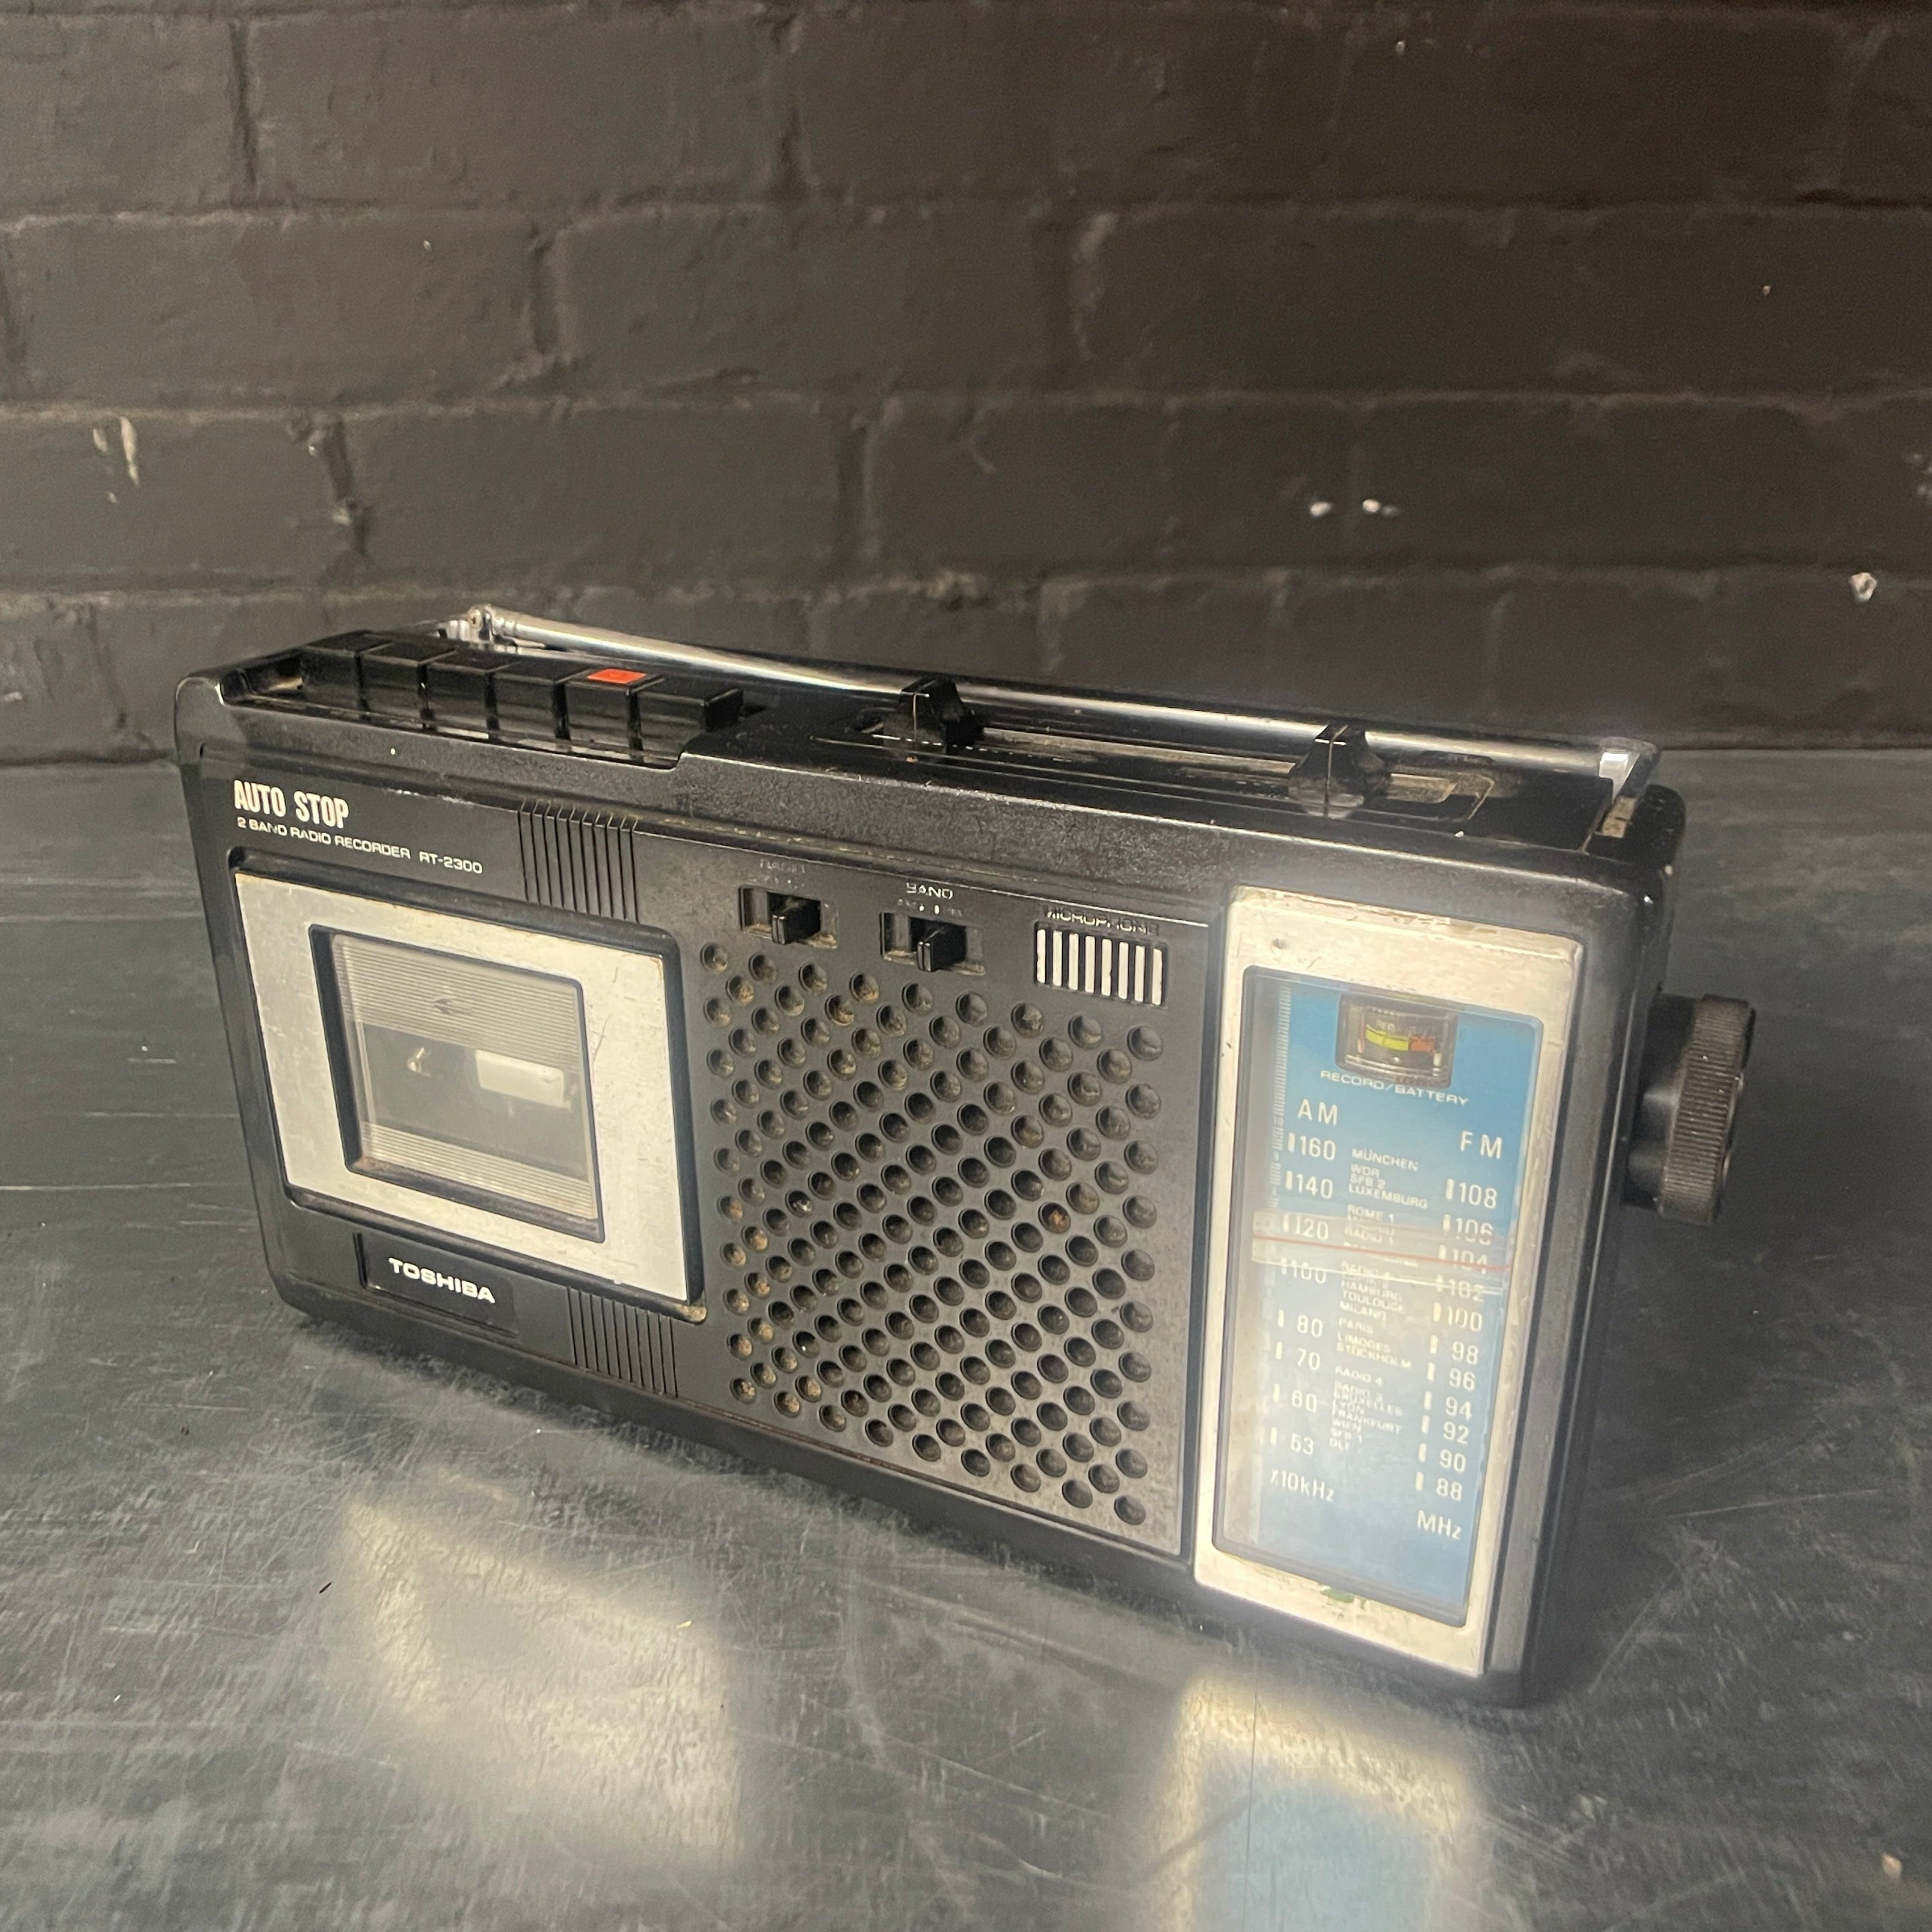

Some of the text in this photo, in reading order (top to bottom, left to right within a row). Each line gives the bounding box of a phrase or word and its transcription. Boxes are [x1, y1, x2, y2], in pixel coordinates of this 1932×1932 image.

[234, 780, 349, 829] AUTO STOP
[238, 817, 482, 875] 2 BAND RADIO RECORDER RT-2300
[1321, 1070, 1469, 1106] RECORD/BATTERY
[1298, 1099, 1338, 1125] AM
[1300, 1135, 1336, 1161] 160
[1460, 1131, 1503, 1159] FM
[1297, 1173, 1333, 1199] 140
[1459, 1182, 1498, 1209] 108
[1296, 1215, 1329, 1240] 120
[1455, 1218, 1493, 1245] 106
[1452, 1248, 1488, 1275] 104
[388, 1257, 495, 1303] TOSHIBA
[1297, 1314, 1323, 1337] 80
[1447, 1305, 1482, 1332] 100
[1297, 1348, 1321, 1370] 70
[1452, 1341, 1479, 1365] 98
[1448, 1368, 1476, 1391] 96
[1445, 1397, 1472, 1421] 94
[1443, 1421, 1469, 1446] 92
[1439, 1449, 1466, 1473] 90
[1436, 1478, 1462, 1501] 88
[1416, 1510, 1462, 1540] MHz
